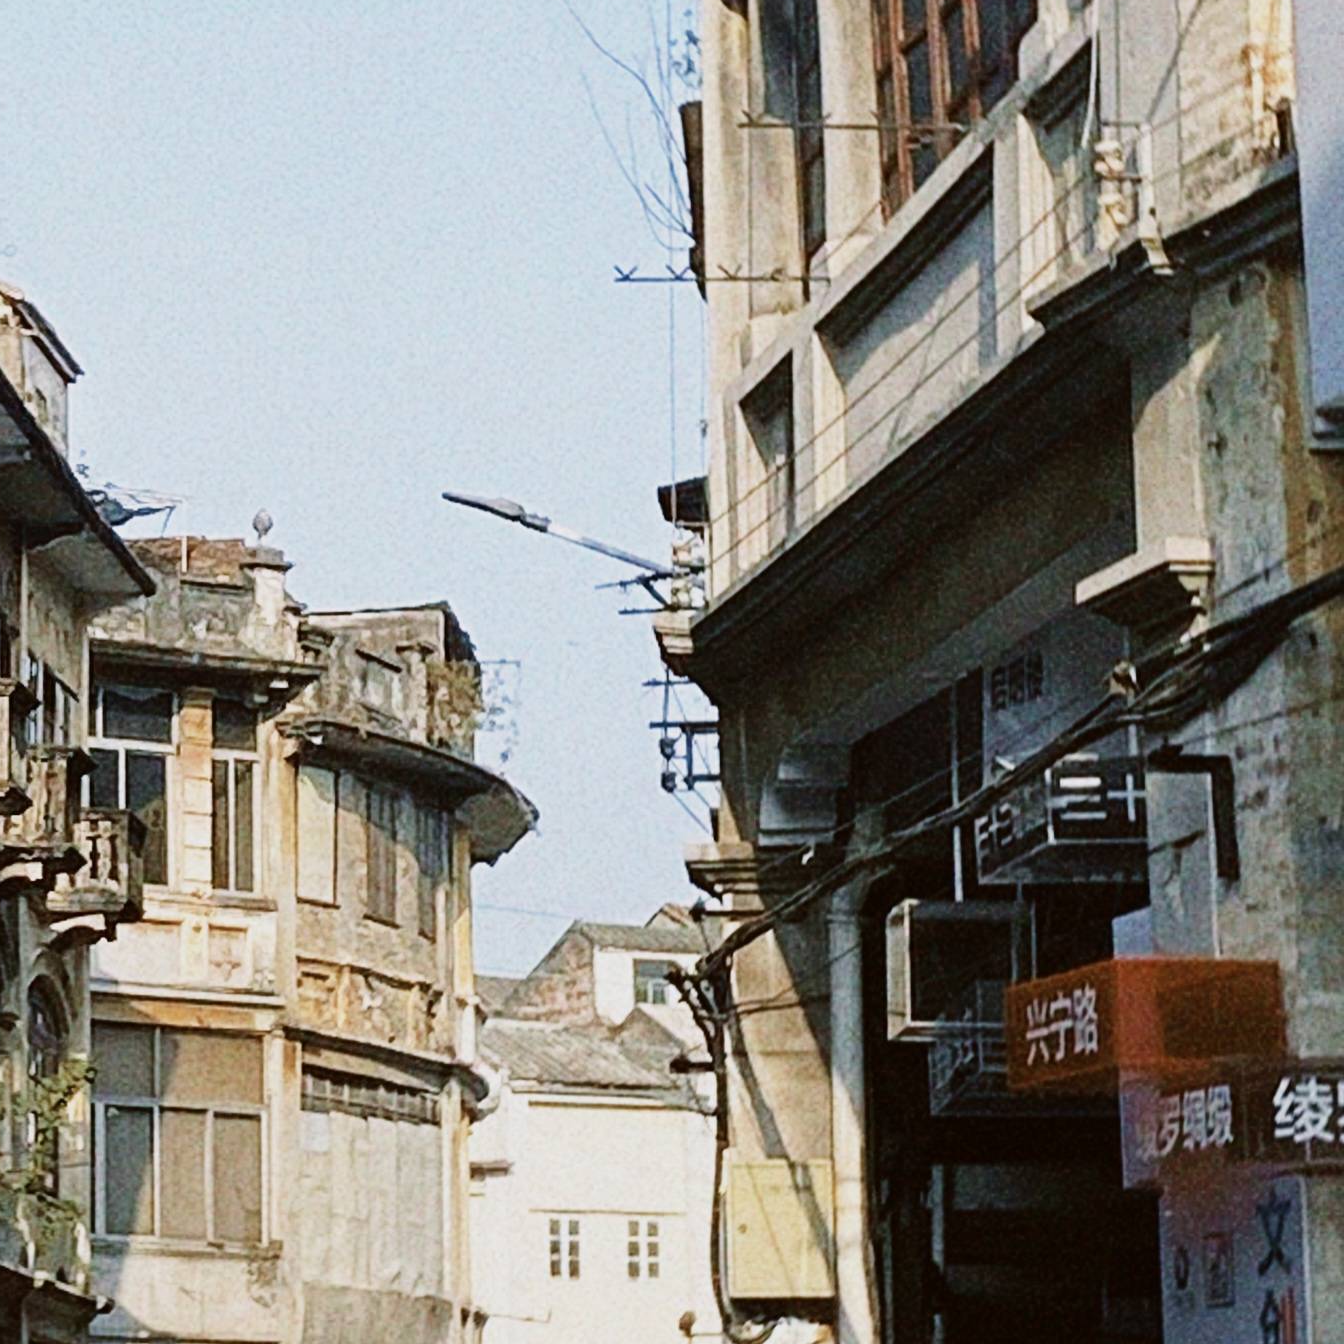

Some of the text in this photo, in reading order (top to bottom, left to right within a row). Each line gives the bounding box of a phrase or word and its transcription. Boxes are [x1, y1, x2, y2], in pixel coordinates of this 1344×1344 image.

[1026, 983, 1098, 1066] 兴宁路
[1273, 1075, 1344, 1144] 绫
